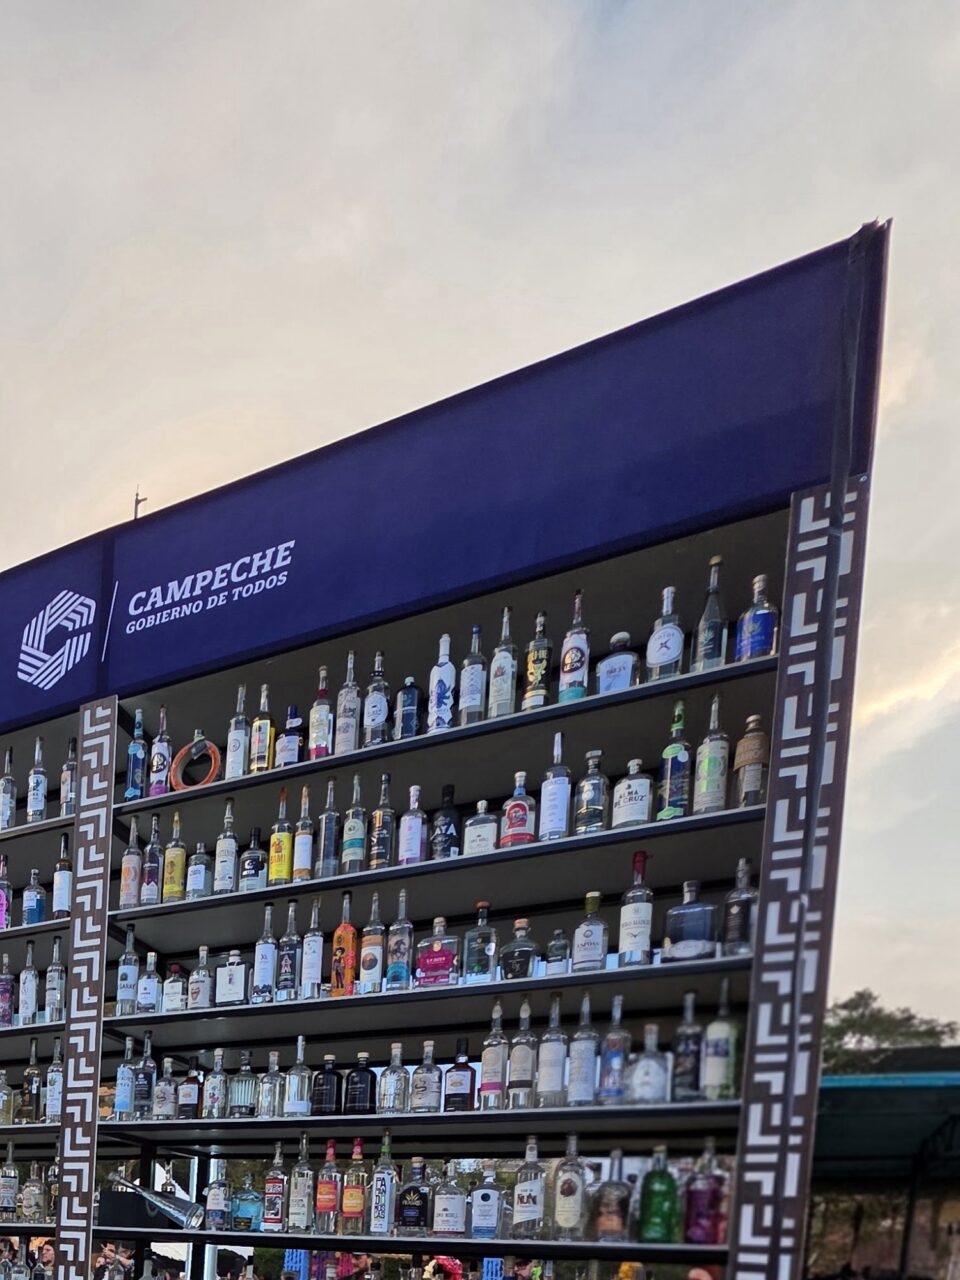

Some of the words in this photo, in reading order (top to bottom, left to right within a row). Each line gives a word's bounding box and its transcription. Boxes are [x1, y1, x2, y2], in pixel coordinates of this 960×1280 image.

[125, 602, 203, 634] GOBIERNO
[206, 591, 228, 610] DE
[232, 571, 288, 601] TODOS
[128, 540, 295, 616] CAMPECHE
